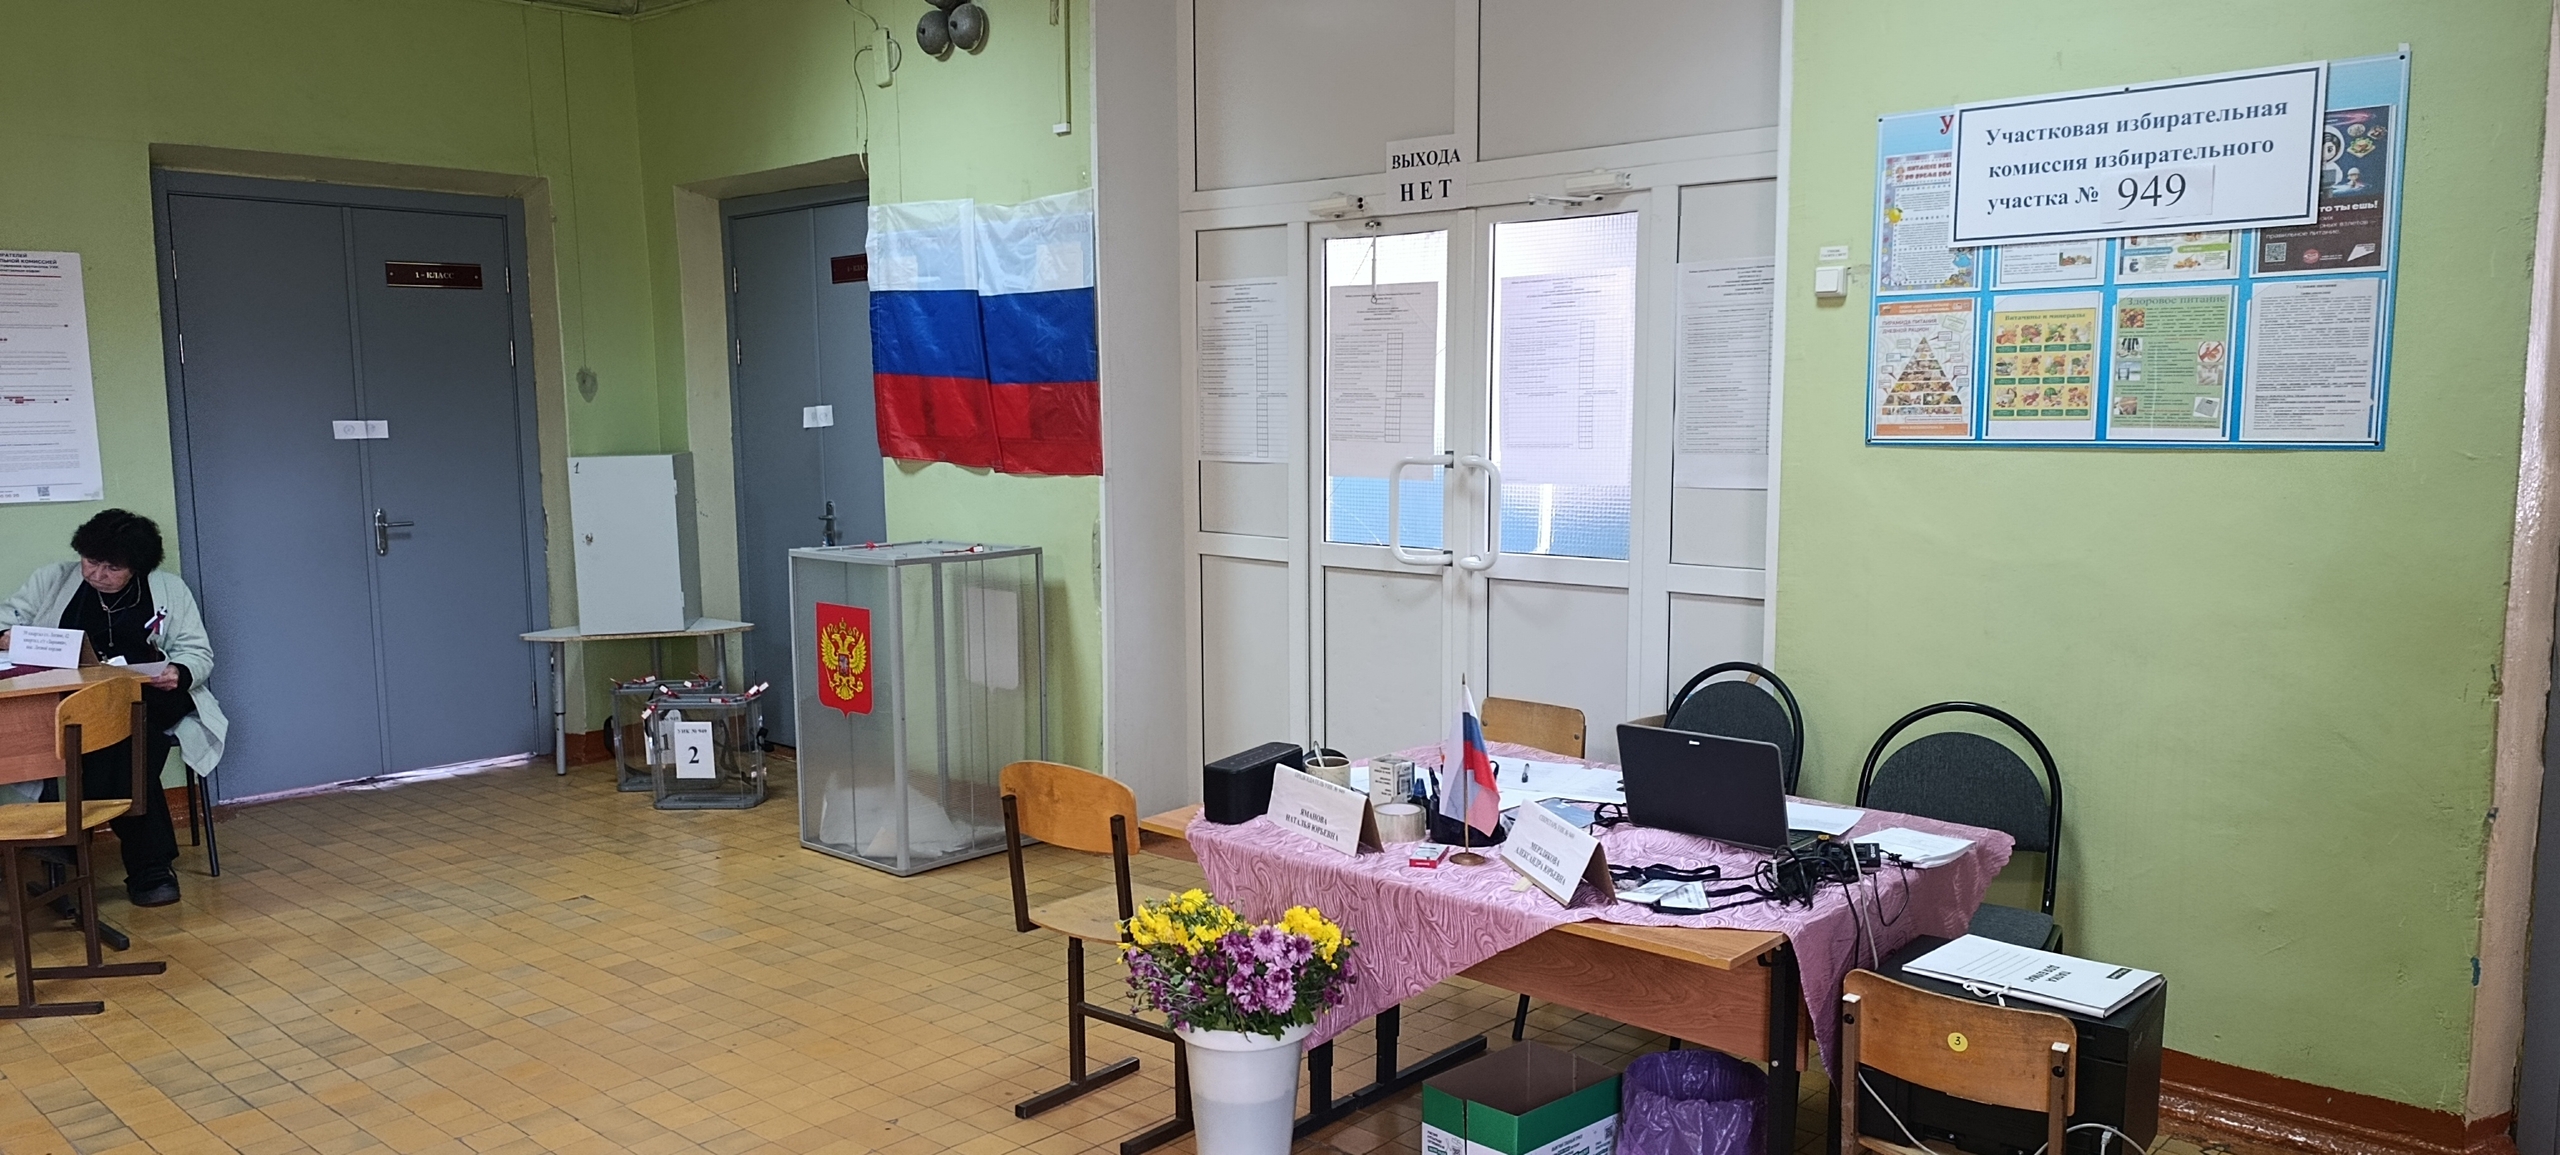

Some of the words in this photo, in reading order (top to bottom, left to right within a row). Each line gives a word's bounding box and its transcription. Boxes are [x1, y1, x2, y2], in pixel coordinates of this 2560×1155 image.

[1985, 122, 2110, 146] Участковая
[2116, 101, 2289, 133] избирательная
[1391, 148, 1461, 170] ВЫХОДА
[1988, 157, 2088, 179] комиссия
[2094, 140, 2274, 169] избирательного
[1400, 178, 1453, 202] НЕТ
[1987, 189, 2069, 215] участка
[2075, 187, 2100, 204] №
[2117, 172, 2187, 211] 949
[2333, 204, 2350, 212] ты
[2351, 200, 2378, 210] ешь!
[2265, 231, 2308, 239] правильное
[426, 271, 455, 279] КЛАСС
[2126, 297, 2177, 306] Здоровое
[2180, 295, 2226, 304] питание
[573, 461, 580, 474] 1
[688, 746, 700, 764] 2
[1300, 808, 1328, 826] ЯМАНОВА
[1285, 813, 1312, 830] НАТАЛЬЯ
[1311, 823, 1339, 842] ЮРЬЕВНА
[1954, 1036, 1962, 1046] 3
